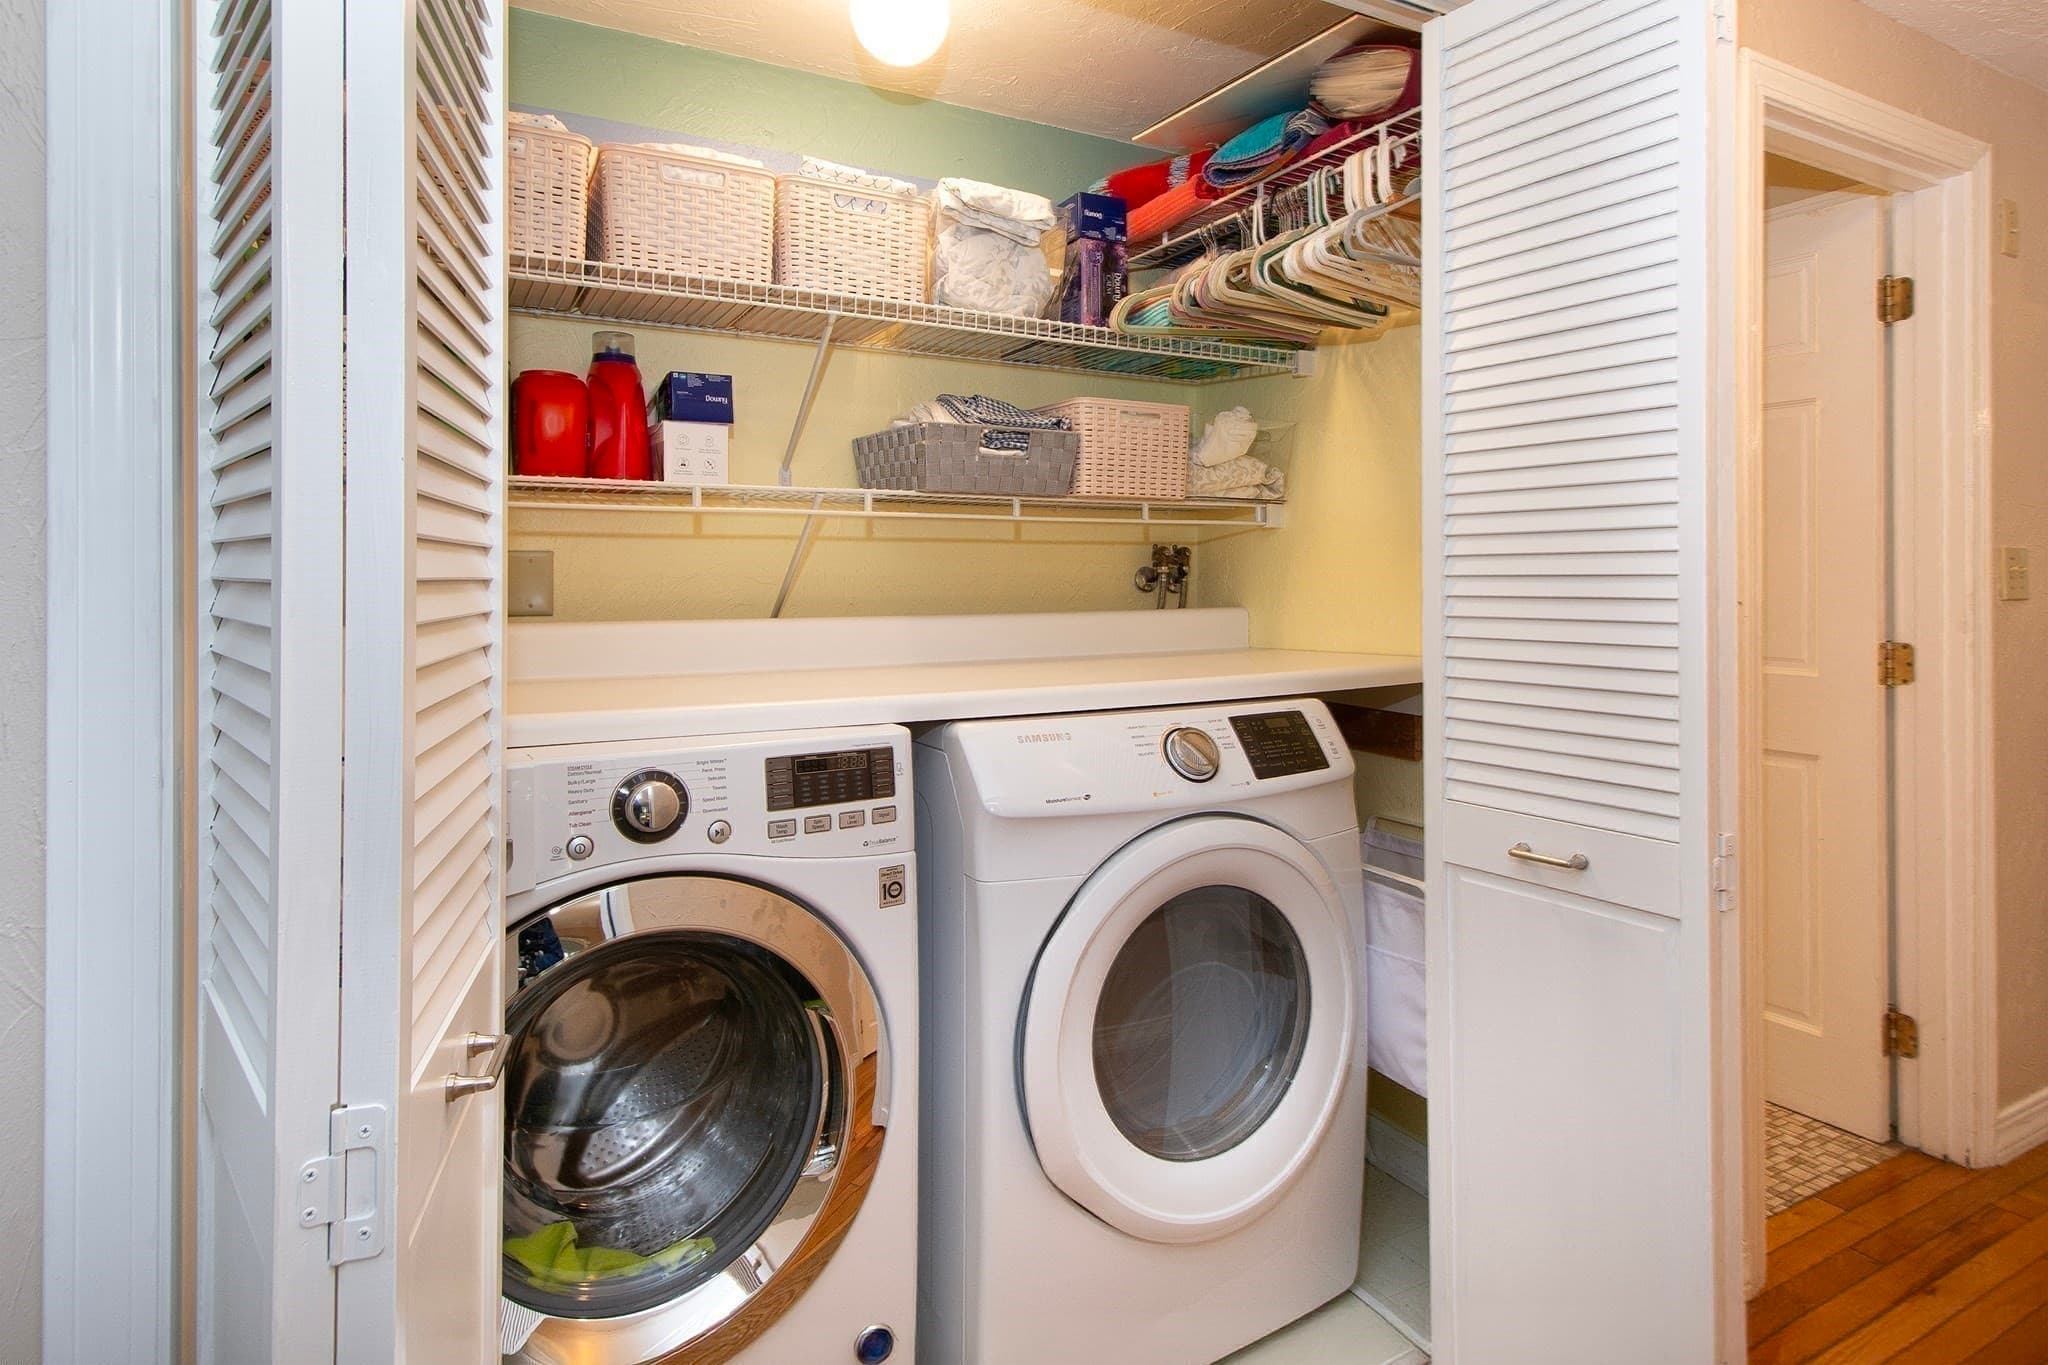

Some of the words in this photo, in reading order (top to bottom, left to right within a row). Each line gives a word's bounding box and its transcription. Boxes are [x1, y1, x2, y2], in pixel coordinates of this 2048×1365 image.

[1112, 272, 1122, 302] Downy
[705, 395, 728, 404] Downy
[1016, 732, 1071, 743] SAMSUNG
[882, 881, 903, 900] 10
